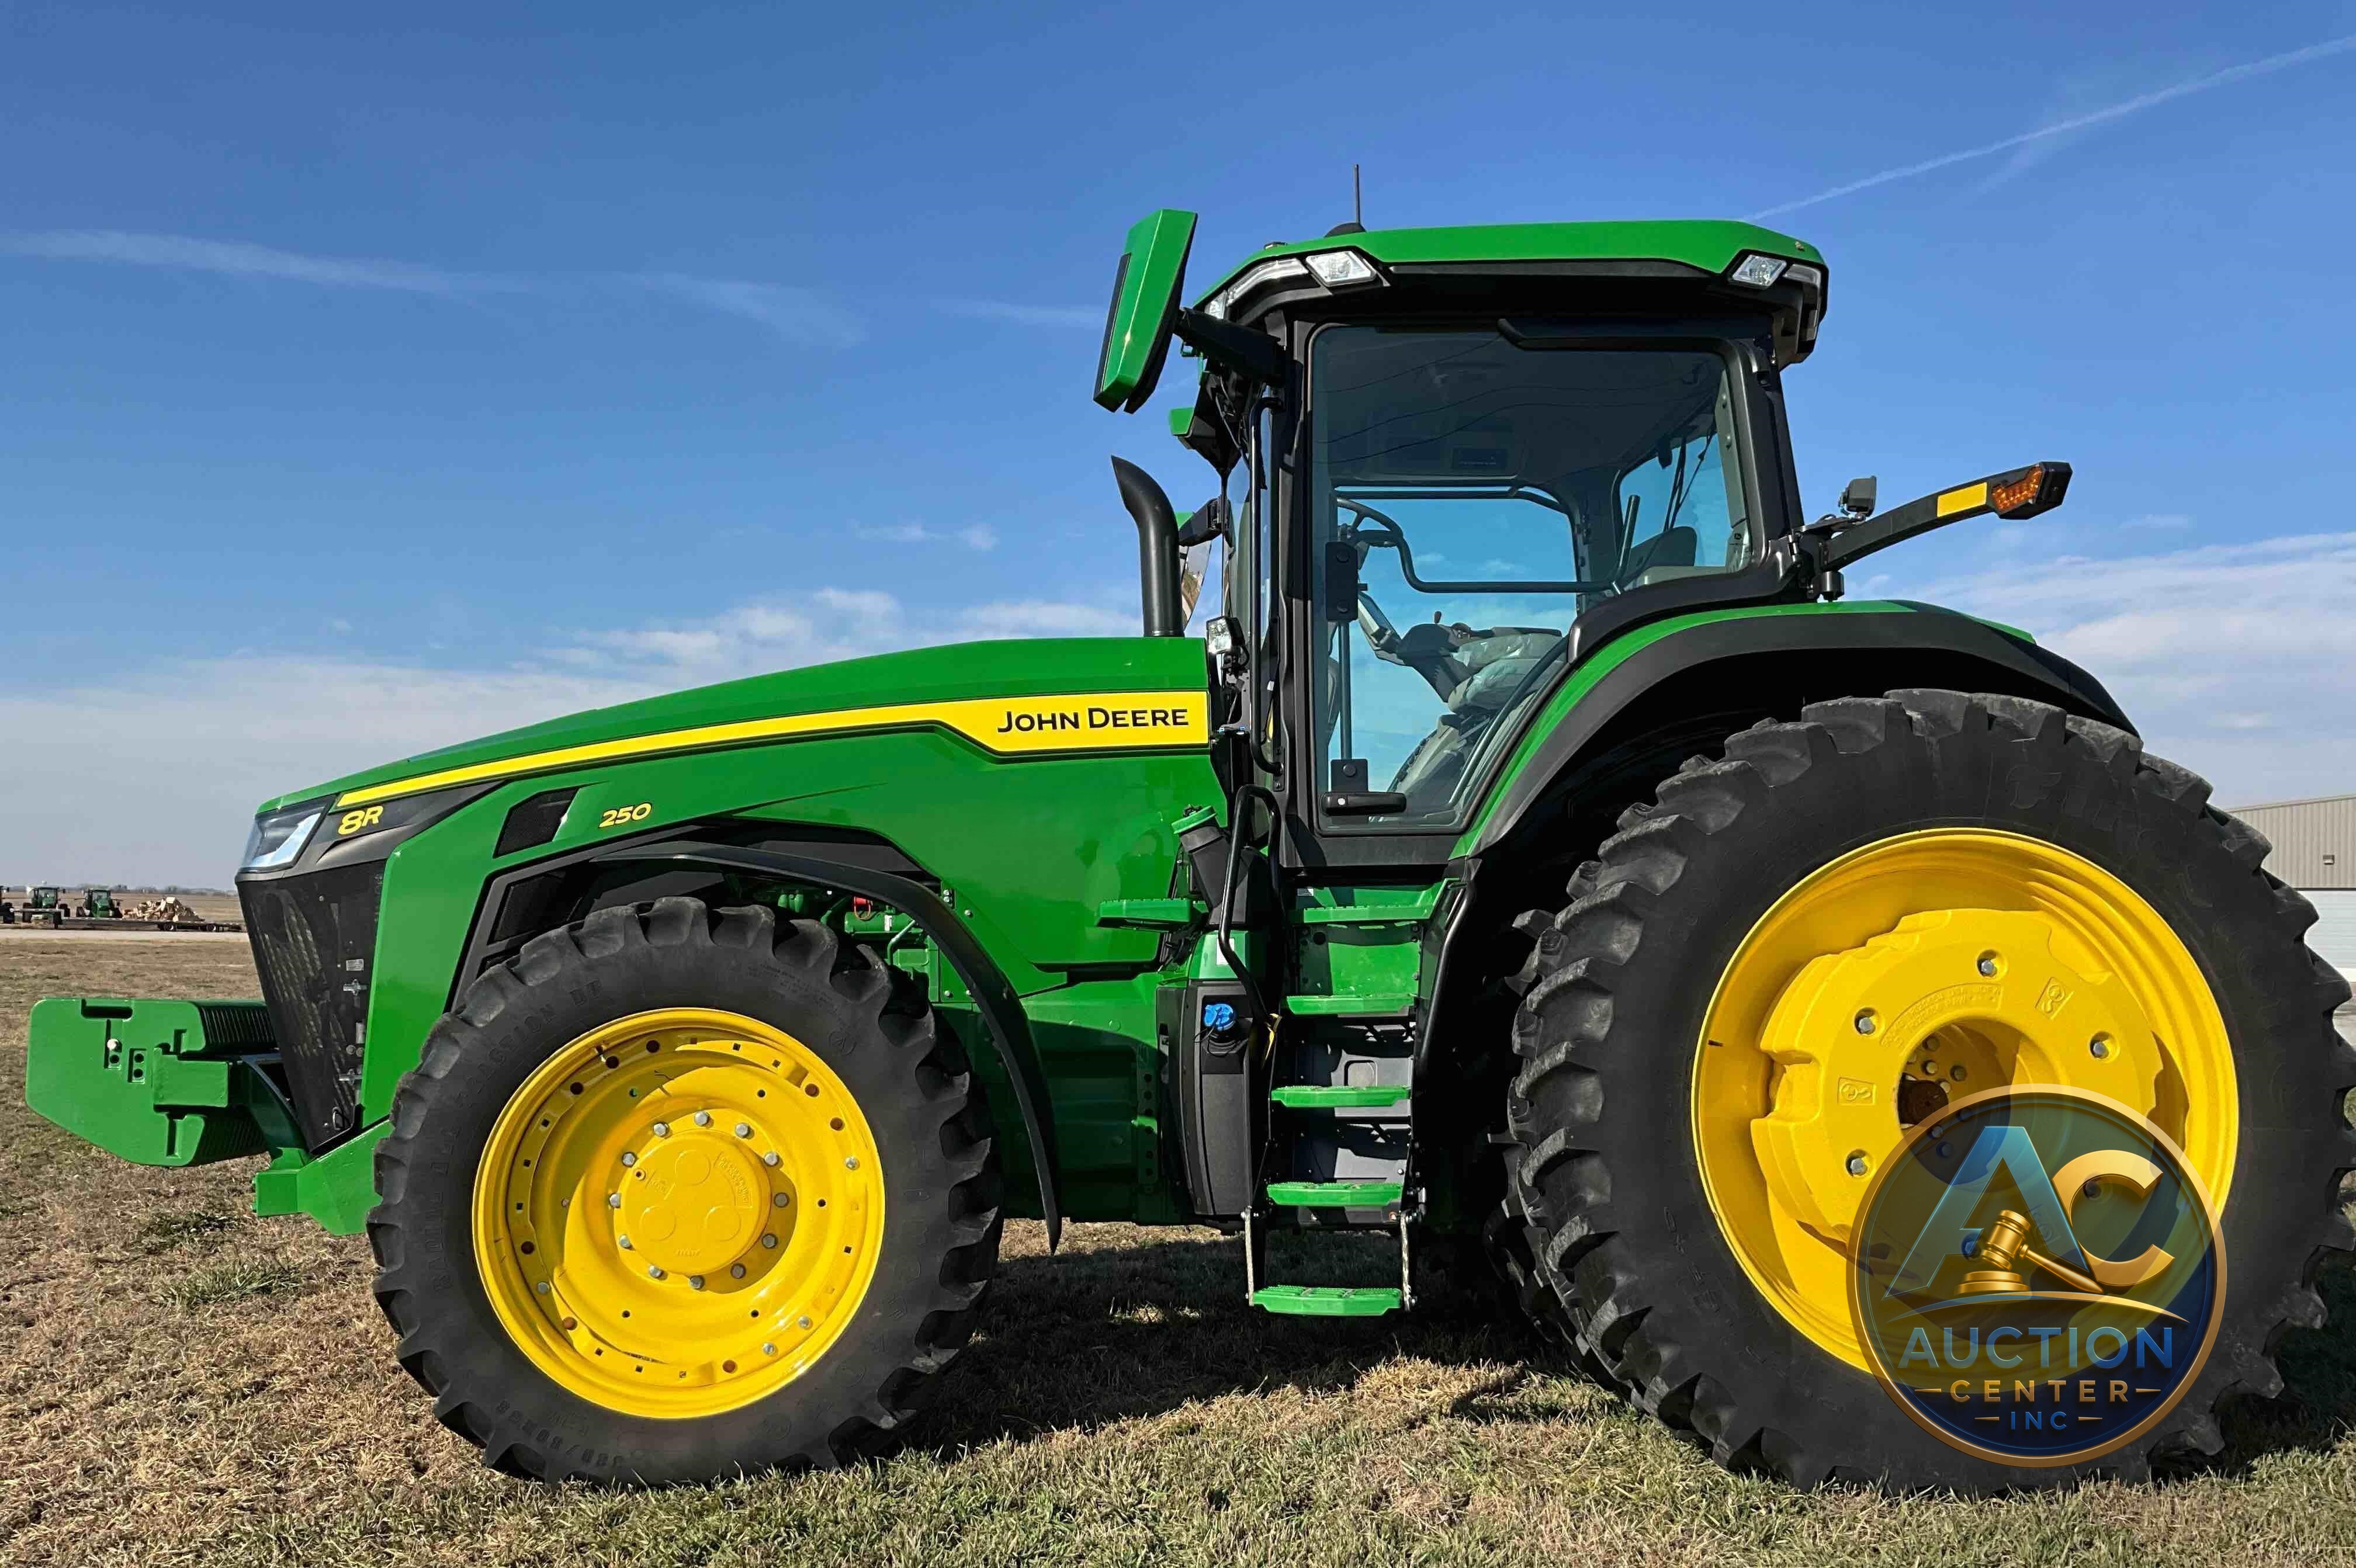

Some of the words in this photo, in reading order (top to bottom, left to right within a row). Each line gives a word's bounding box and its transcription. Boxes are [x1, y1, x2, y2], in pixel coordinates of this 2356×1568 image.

[997, 710, 1080, 733] JOHN
[1087, 707, 1189, 729] DEERE
[337, 805, 384, 835] 8R
[599, 802, 652, 828] 250
